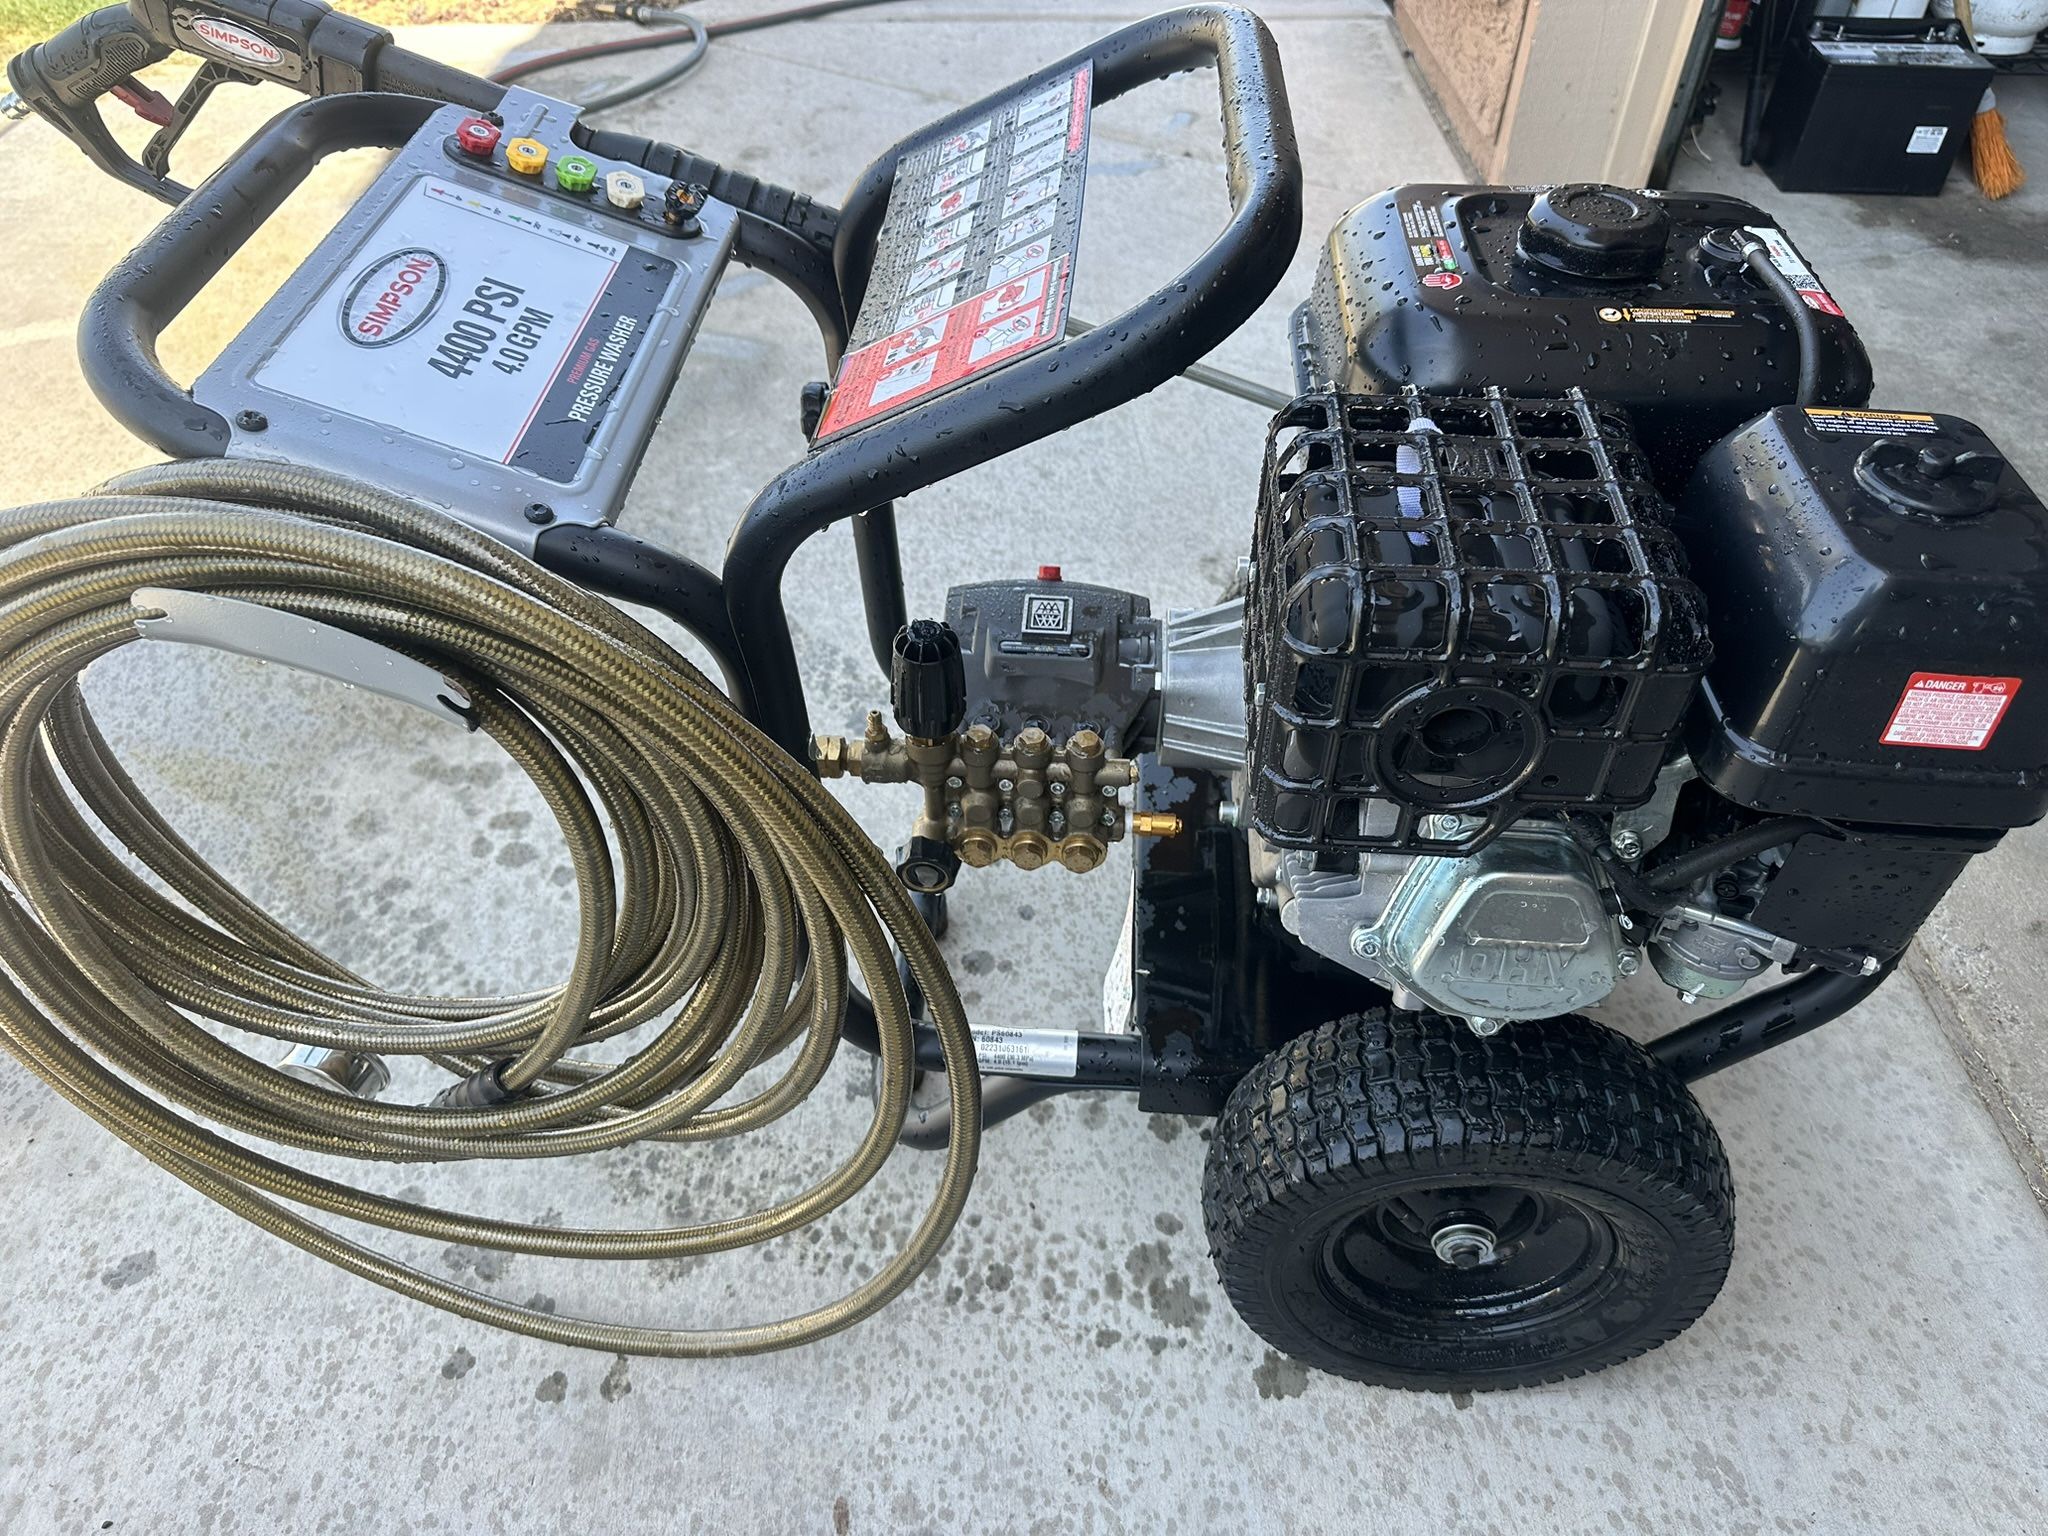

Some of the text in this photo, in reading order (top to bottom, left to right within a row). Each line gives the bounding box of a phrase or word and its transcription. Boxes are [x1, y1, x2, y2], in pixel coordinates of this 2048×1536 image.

[200, 24, 274, 59] SIMPSON
[358, 257, 434, 337] SIMPSON
[427, 277, 526, 380] 4400 PSI
[491, 306, 554, 375] 4.0 GPM
[567, 337, 600, 384] PREMIUM GAS
[568, 314, 638, 422] PRESSURE WASHER
[1925, 680, 1966, 691] DANGER
[982, 1035, 1003, 1043] 60843
[991, 1030, 1023, 1038] PS60843
